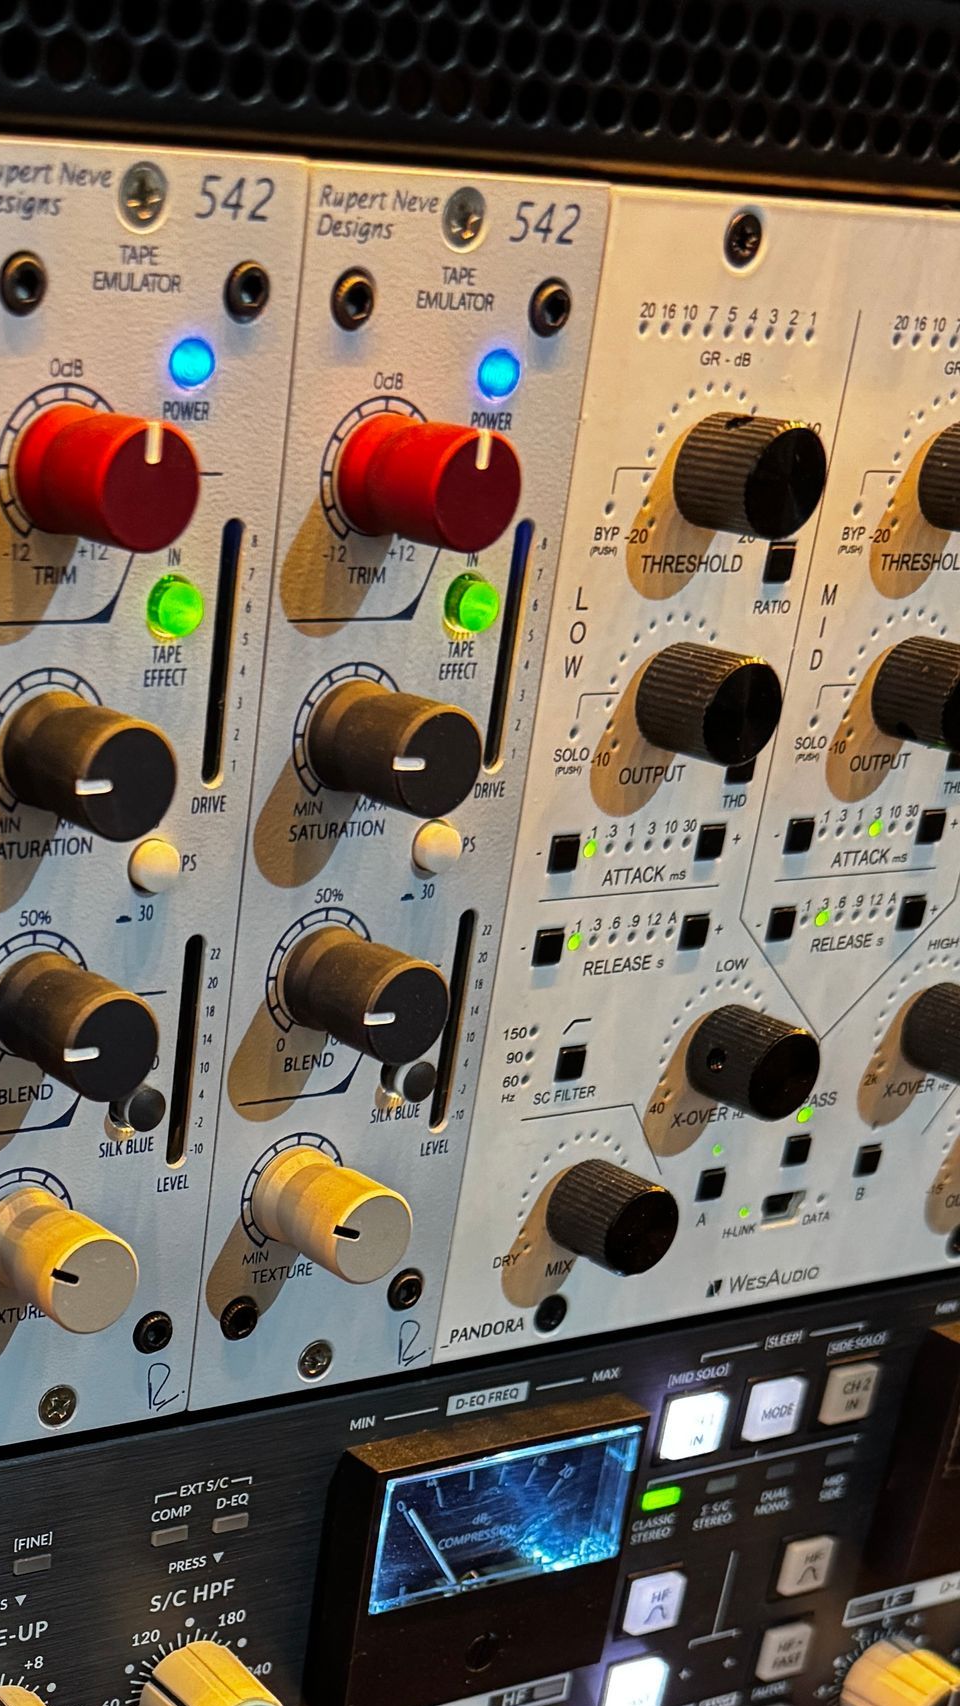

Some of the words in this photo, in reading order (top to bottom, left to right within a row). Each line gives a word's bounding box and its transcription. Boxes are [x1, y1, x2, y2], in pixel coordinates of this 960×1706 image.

[61, 162, 112, 188] Neve
[195, 175, 275, 222] 542
[319, 184, 387, 210] Rupert
[392, 190, 439, 213] Neve
[318, 214, 394, 243] Designs
[509, 201, 581, 245] 542
[119, 245, 159, 266] TAPE
[92, 271, 181, 292] EMULATOR
[442, 267, 477, 286] TAPE
[416, 291, 494, 311] EMULATOR
[49, 358, 83, 378] 0dB
[700, 351, 721, 366] GR
[734, 352, 751, 367] dB
[373, 372, 403, 390] 0dB
[162, 401, 209, 421] POWER
[471, 412, 512, 431] POWER
[593, 526, 619, 541] BYP
[624, 529, 648, 544] -20
[841, 526, 866, 541] BYP
[869, 529, 890, 544] -20
[590, 545, 618, 557] (PUSH)
[838, 543, 863, 555] (PUSH)
[641, 555, 742, 574] THRESHOLD
[34, 566, 77, 584] TRIM
[348, 567, 386, 584] TRIM
[753, 600, 791, 614] RATIO
[152, 646, 182, 663] TAPE
[448, 641, 474, 658] TAPE
[144, 668, 187, 687] EFFECT
[439, 663, 478, 680] EFFECT
[794, 736, 827, 751] SOLO
[553, 748, 589, 762] SOLO
[591, 751, 610, 767] -10
[795, 751, 820, 762] (PUSH)
[850, 753, 911, 772] OUTPUT
[555, 765, 582, 777] (PUSH)
[619, 765, 686, 784] OUTPUT
[474, 781, 505, 799] DRIVE
[191, 795, 227, 814] DRIVE
[293, 801, 322, 816] MIN
[721, 794, 747, 808] THD
[289, 819, 385, 842] SATURATION
[831, 848, 890, 868] ATTACK
[602, 865, 666, 887] ATTACK
[314, 888, 344, 904] 50%
[420, 883, 435, 900] 30
[19, 911, 52, 926] 50%
[138, 905, 154, 921] 30
[810, 933, 873, 953] RELEASE
[928, 937, 960, 951] HIGH
[583, 955, 652, 976] RELEASE
[716, 958, 749, 973] LOW
[502, 1025, 527, 1041] 150
[284, 1053, 334, 1072] BLEND
[506, 1049, 523, 1065] 90
[502, 1073, 520, 1089] 60
[883, 1079, 935, 1098] X-OVER
[533, 1090, 551, 1106] SC
[554, 1085, 595, 1103] FILTER
[370, 1107, 393, 1124] SILK
[395, 1104, 419, 1121] BLUE
[649, 1102, 665, 1116] 40
[671, 1107, 728, 1130] X-OVER
[99, 1140, 123, 1157] SILK
[126, 1137, 154, 1154] BLUE
[420, 1139, 449, 1157] LEVEL
[157, 1174, 189, 1193] LEVEL
[802, 1211, 830, 1225] DATA
[721, 1223, 756, 1239] H-LINK
[242, 1251, 269, 1265] MIN
[493, 1253, 520, 1270] DRY
[252, 1262, 313, 1284] TEXTURE
[545, 1258, 573, 1277] MIX
[592, 1367, 620, 1383] MAX
[456, 1393, 485, 1410] D-EQ
[488, 1388, 519, 1405] FREQ
[761, 1403, 794, 1422] MODE
[349, 1415, 376, 1431] MIN
[180, 1482, 204, 1497] EXT
[206, 1477, 229, 1492] S/C
[216, 1493, 249, 1510] D-EQ
[754, 1499, 790, 1516] MONO
[151, 1505, 191, 1523] COMP
[631, 1513, 676, 1532] CLASSIC
[13, 1532, 53, 1553] [FINE]
[438, 1524, 517, 1551] COMPRESSION
[630, 1527, 671, 1545] STEREO
[169, 1556, 207, 1574] PRESS
[150, 1590, 187, 1612] S/C
[193, 1578, 235, 1604] HPF
